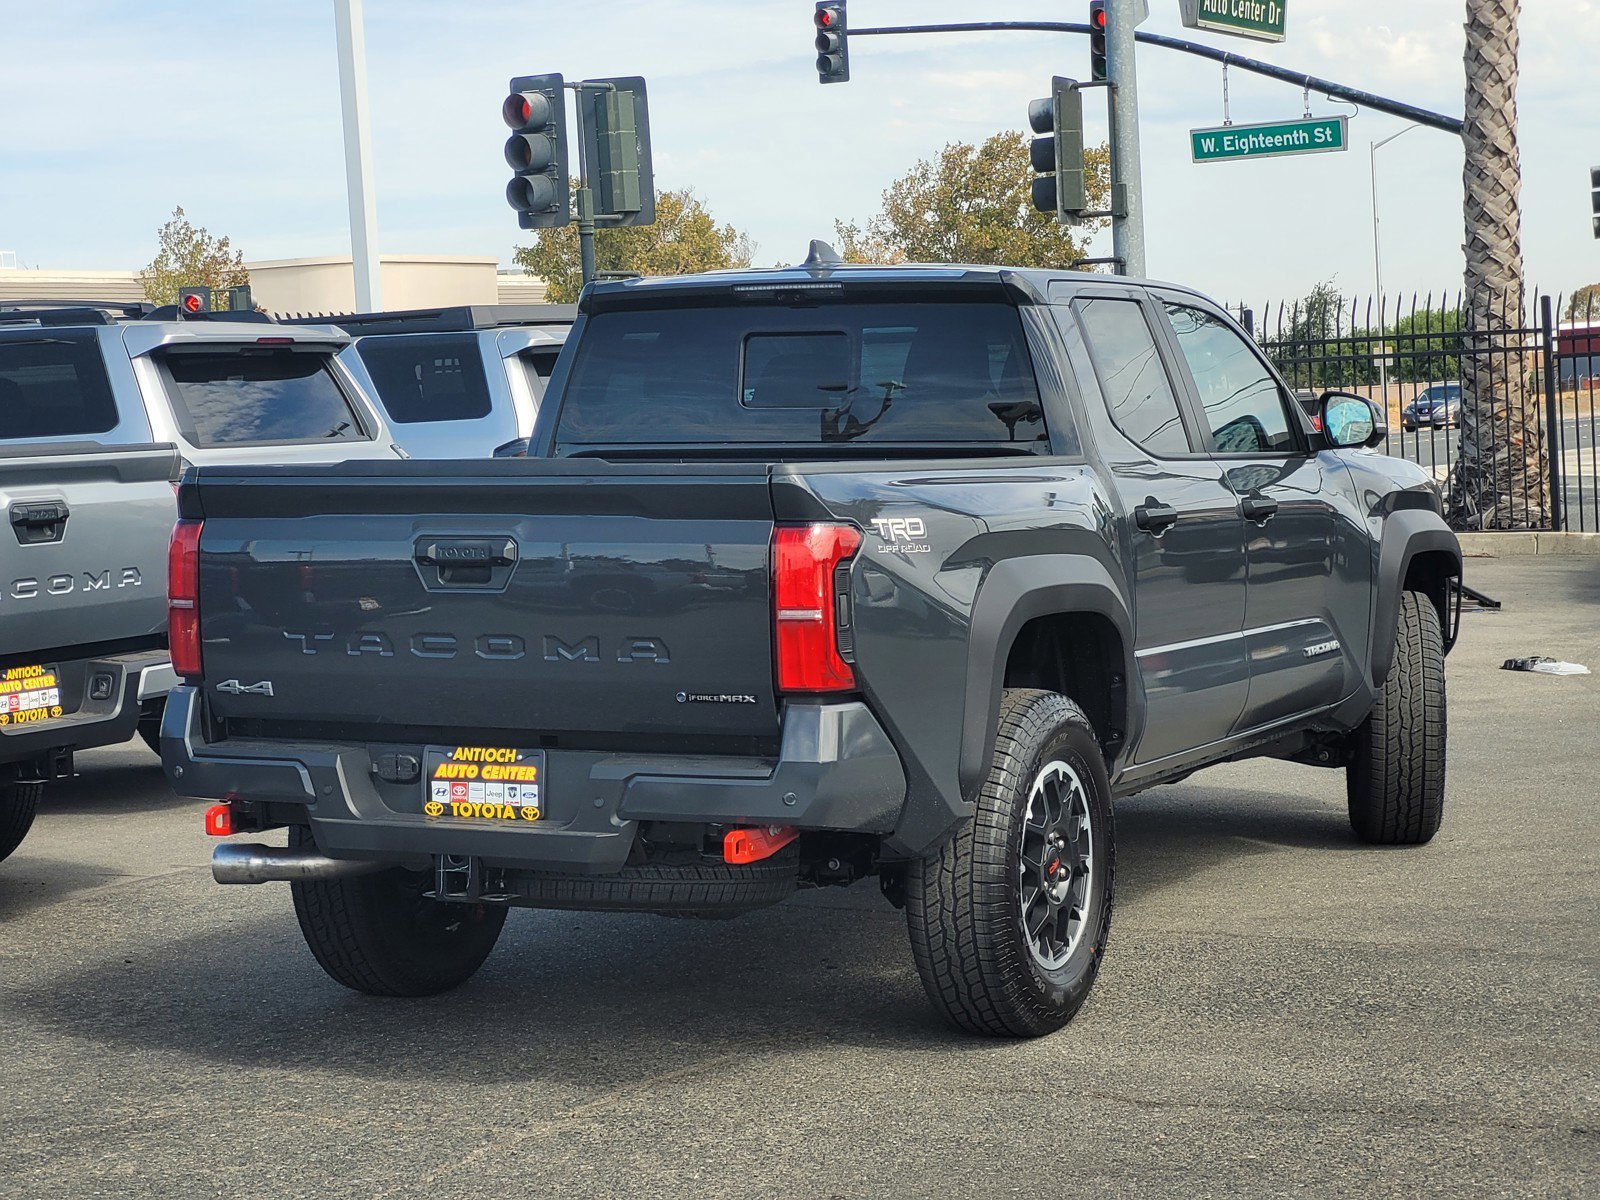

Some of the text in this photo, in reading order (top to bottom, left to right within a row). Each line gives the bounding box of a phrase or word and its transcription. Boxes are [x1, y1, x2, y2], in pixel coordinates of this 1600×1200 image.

[1203, 0, 1281, 25] Auto Center Dr
[1200, 126, 1333, 154] W. Eighteenth St
[870, 517, 925, 541] TRD
[438, 547, 487, 559] TOYOTA
[878, 543, 931, 553] OFF ROAD
[0, 566, 142, 600] COMA
[283, 630, 671, 664] TACOMA
[6, 665, 42, 681] ANTIOCH
[22, 674, 56, 690] CENTER
[12, 707, 49, 723] TOYOTA
[452, 747, 517, 763] ANTIOCH
[433, 763, 537, 782] AUTO CENTER
[487, 790, 502, 798] Jeep
[450, 802, 516, 820] TOYOTA
